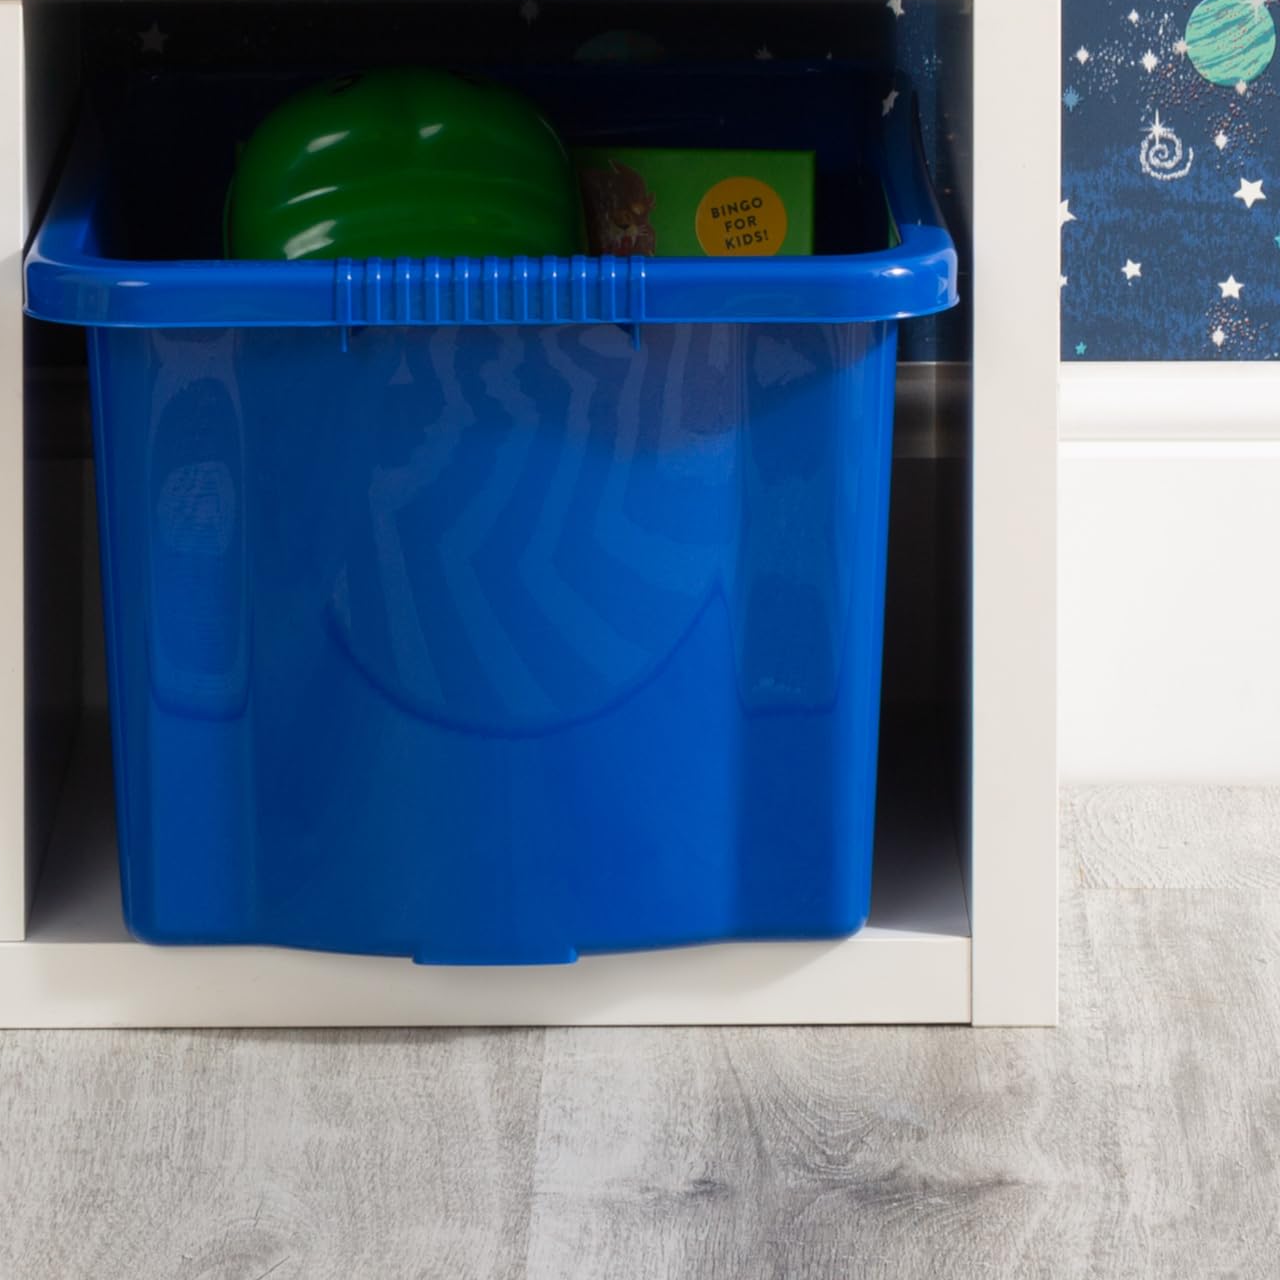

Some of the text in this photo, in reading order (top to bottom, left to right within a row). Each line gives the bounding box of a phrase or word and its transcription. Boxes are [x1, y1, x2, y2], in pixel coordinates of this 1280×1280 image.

[710, 196, 763, 219] BINGO
[724, 215, 758, 232] FOR
[725, 229, 769, 250] KIDS!
